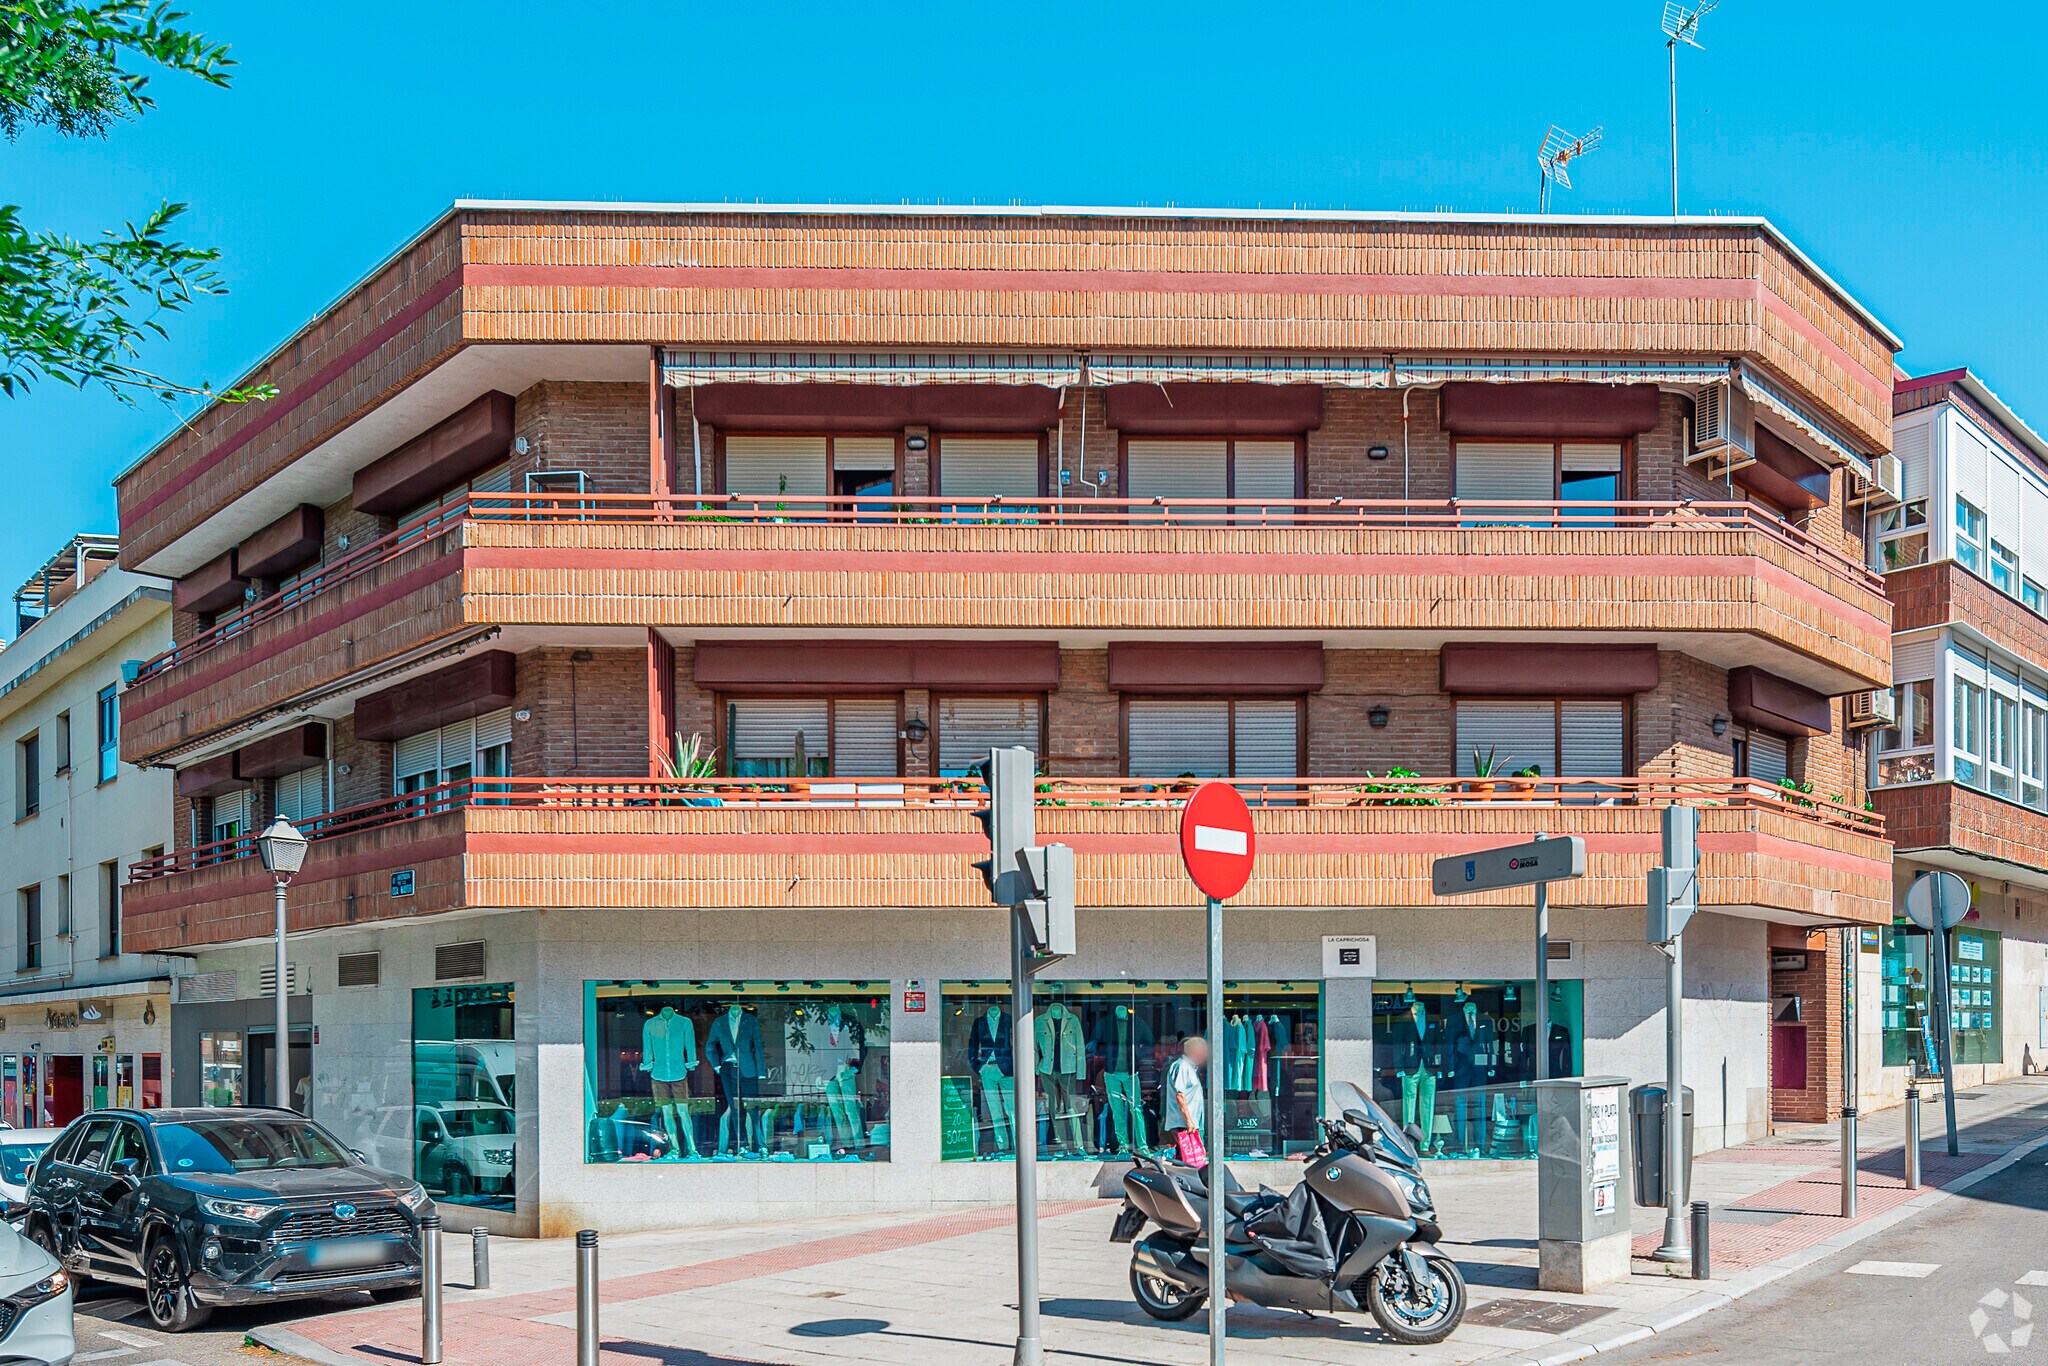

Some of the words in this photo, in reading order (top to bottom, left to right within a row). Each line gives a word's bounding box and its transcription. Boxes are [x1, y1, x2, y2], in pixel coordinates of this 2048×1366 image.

[1520, 859, 1539, 869] MOSA
[1605, 1103, 1617, 1117] PLATA
[1237, 1118, 1258, 1126] MMX
